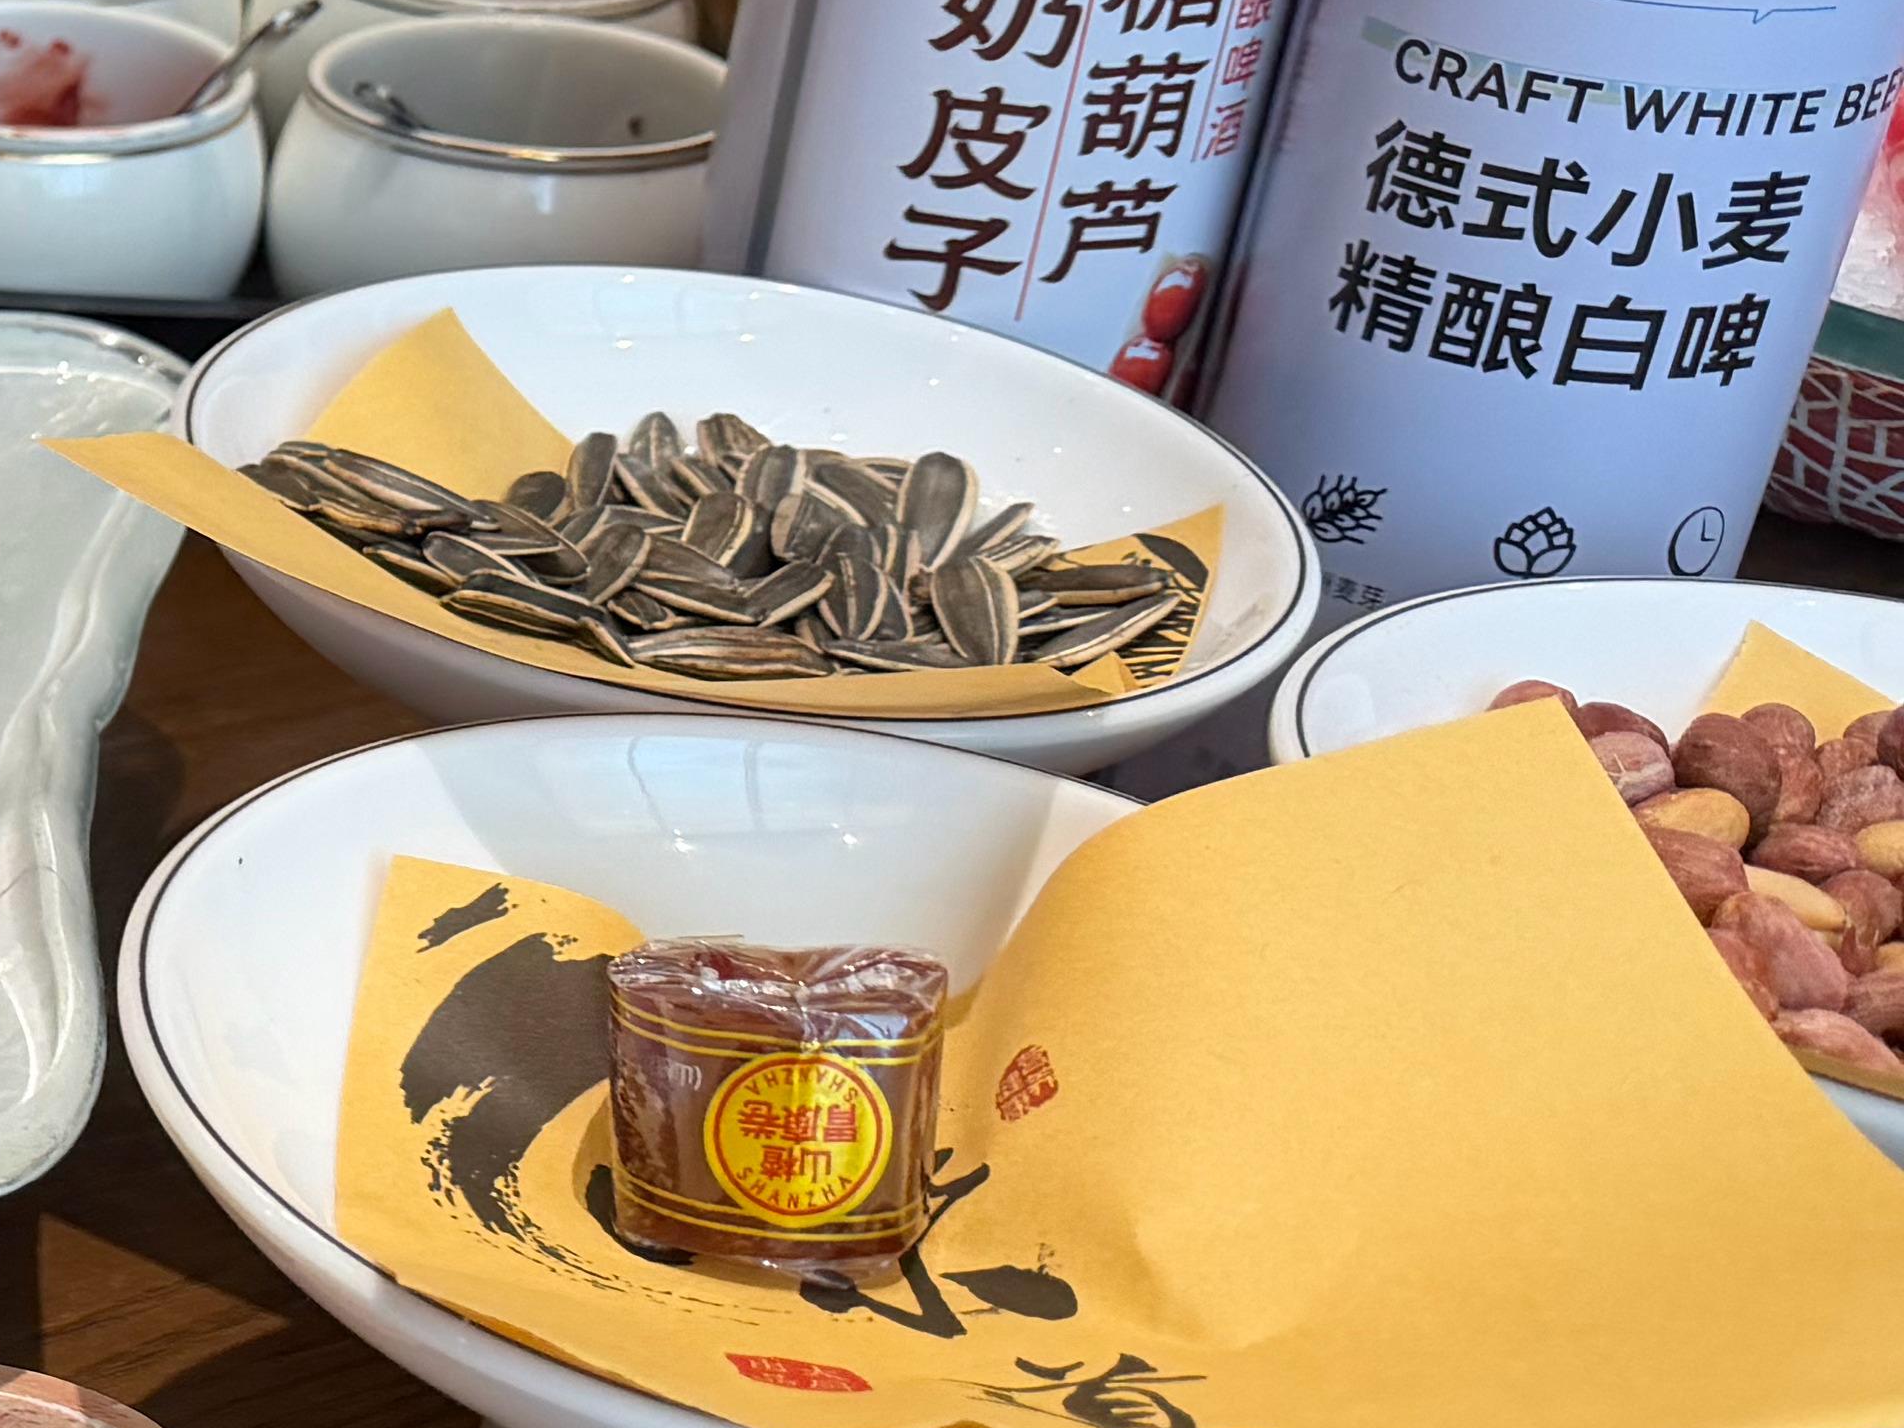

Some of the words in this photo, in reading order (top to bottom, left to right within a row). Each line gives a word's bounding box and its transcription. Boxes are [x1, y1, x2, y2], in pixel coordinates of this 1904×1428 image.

[1395, 38, 1605, 124] CRAFT
[1622, 84, 1827, 137] WHITE
[1365, 118, 1811, 271] 德式小麦
[1328, 238, 1771, 392] 精酿白啤
[737, 1099, 859, 1145] 胃康卷
[737, 1166, 853, 1210] SHANZHA
